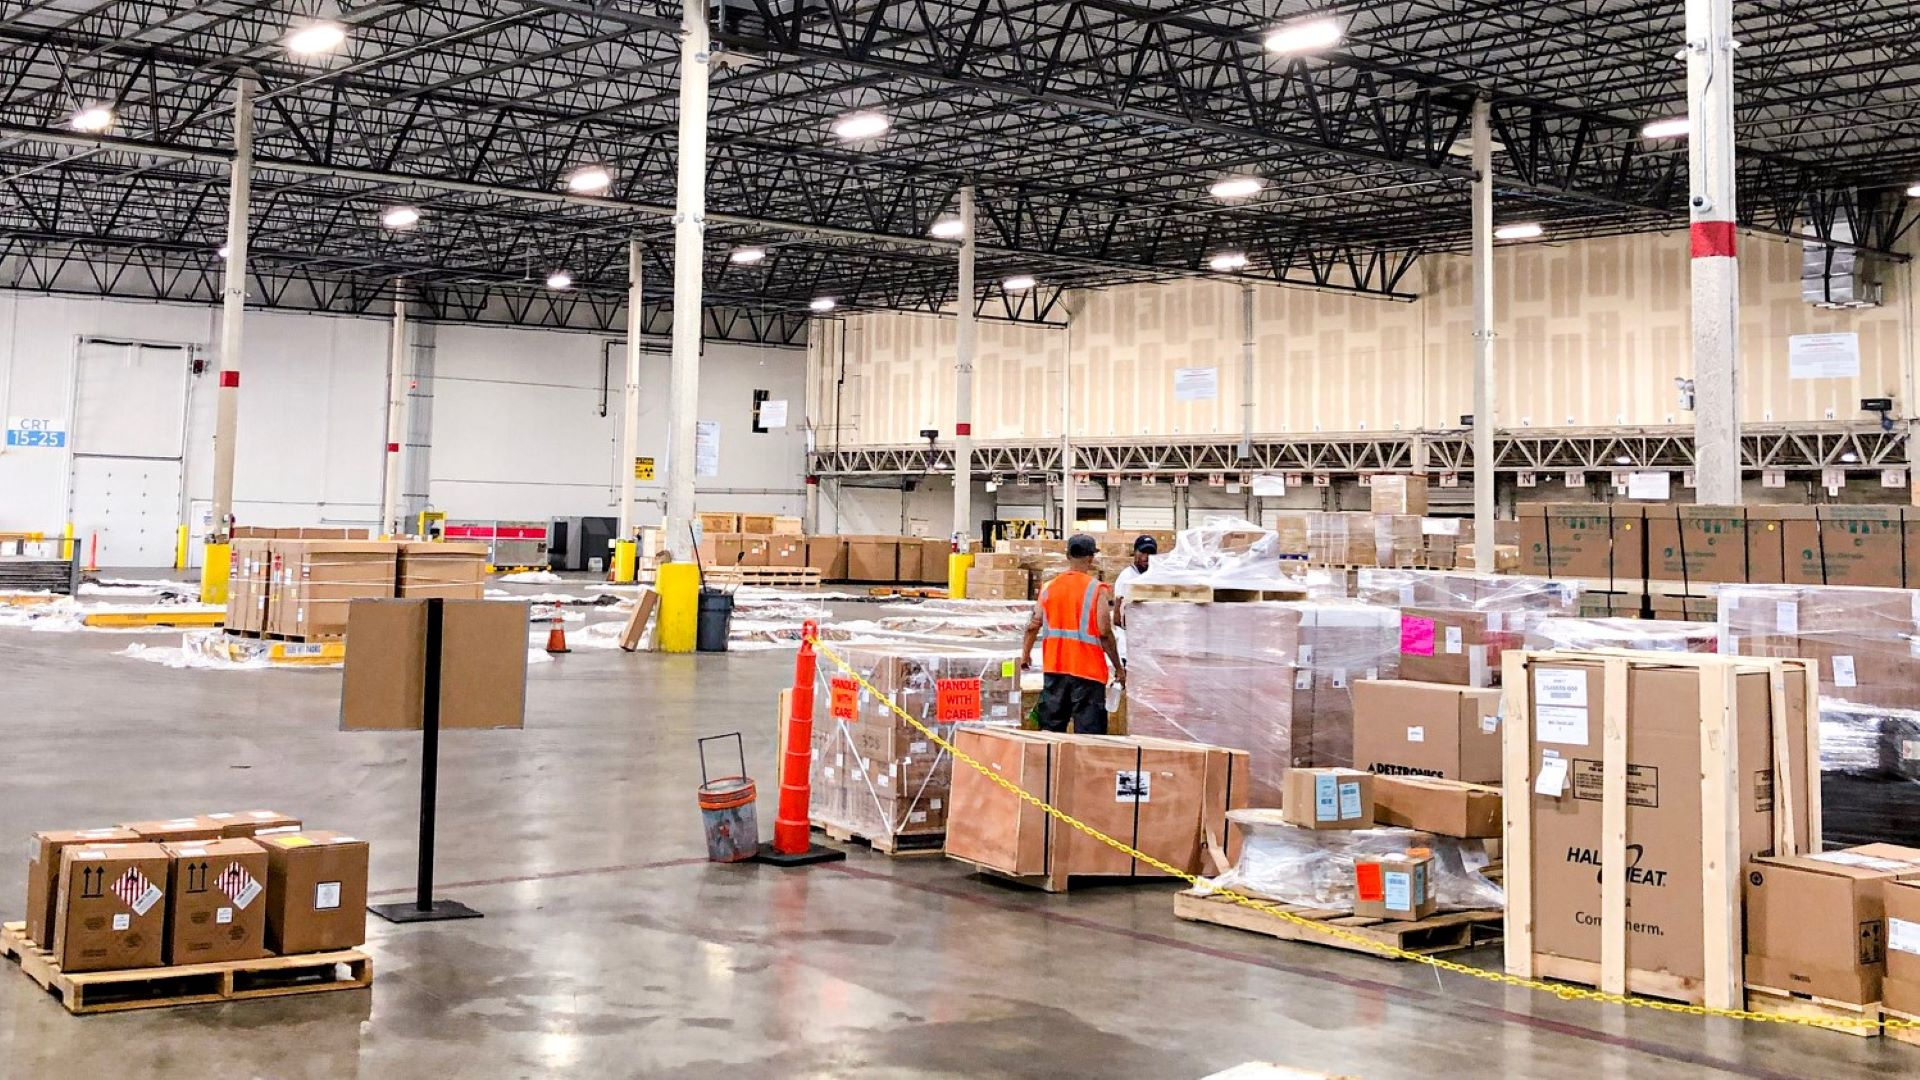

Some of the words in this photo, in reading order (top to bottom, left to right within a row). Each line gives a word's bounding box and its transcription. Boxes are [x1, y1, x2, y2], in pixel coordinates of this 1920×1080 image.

[20, 419, 50, 430] CRT
[13, 431, 59, 446] 15-25
[1111, 474, 1118, 484] Y
[1145, 473, 1152, 484] X
[1176, 475, 1186, 484] W
[1213, 474, 1220, 484] V
[1242, 474, 1249, 484] U
[1290, 474, 1298, 484] T
[1318, 474, 1325, 484] S
[1364, 474, 1371, 484] R
[1523, 473, 1531, 484] N
[1569, 474, 1581, 485] M
[1618, 473, 1625, 484] L
[832, 679, 857, 691] HANDLE
[938, 679, 980, 691] HANDLE
[946, 694, 972, 705] WITH
[835, 706, 853, 719] CARE
[945, 709, 973, 720] CARE
